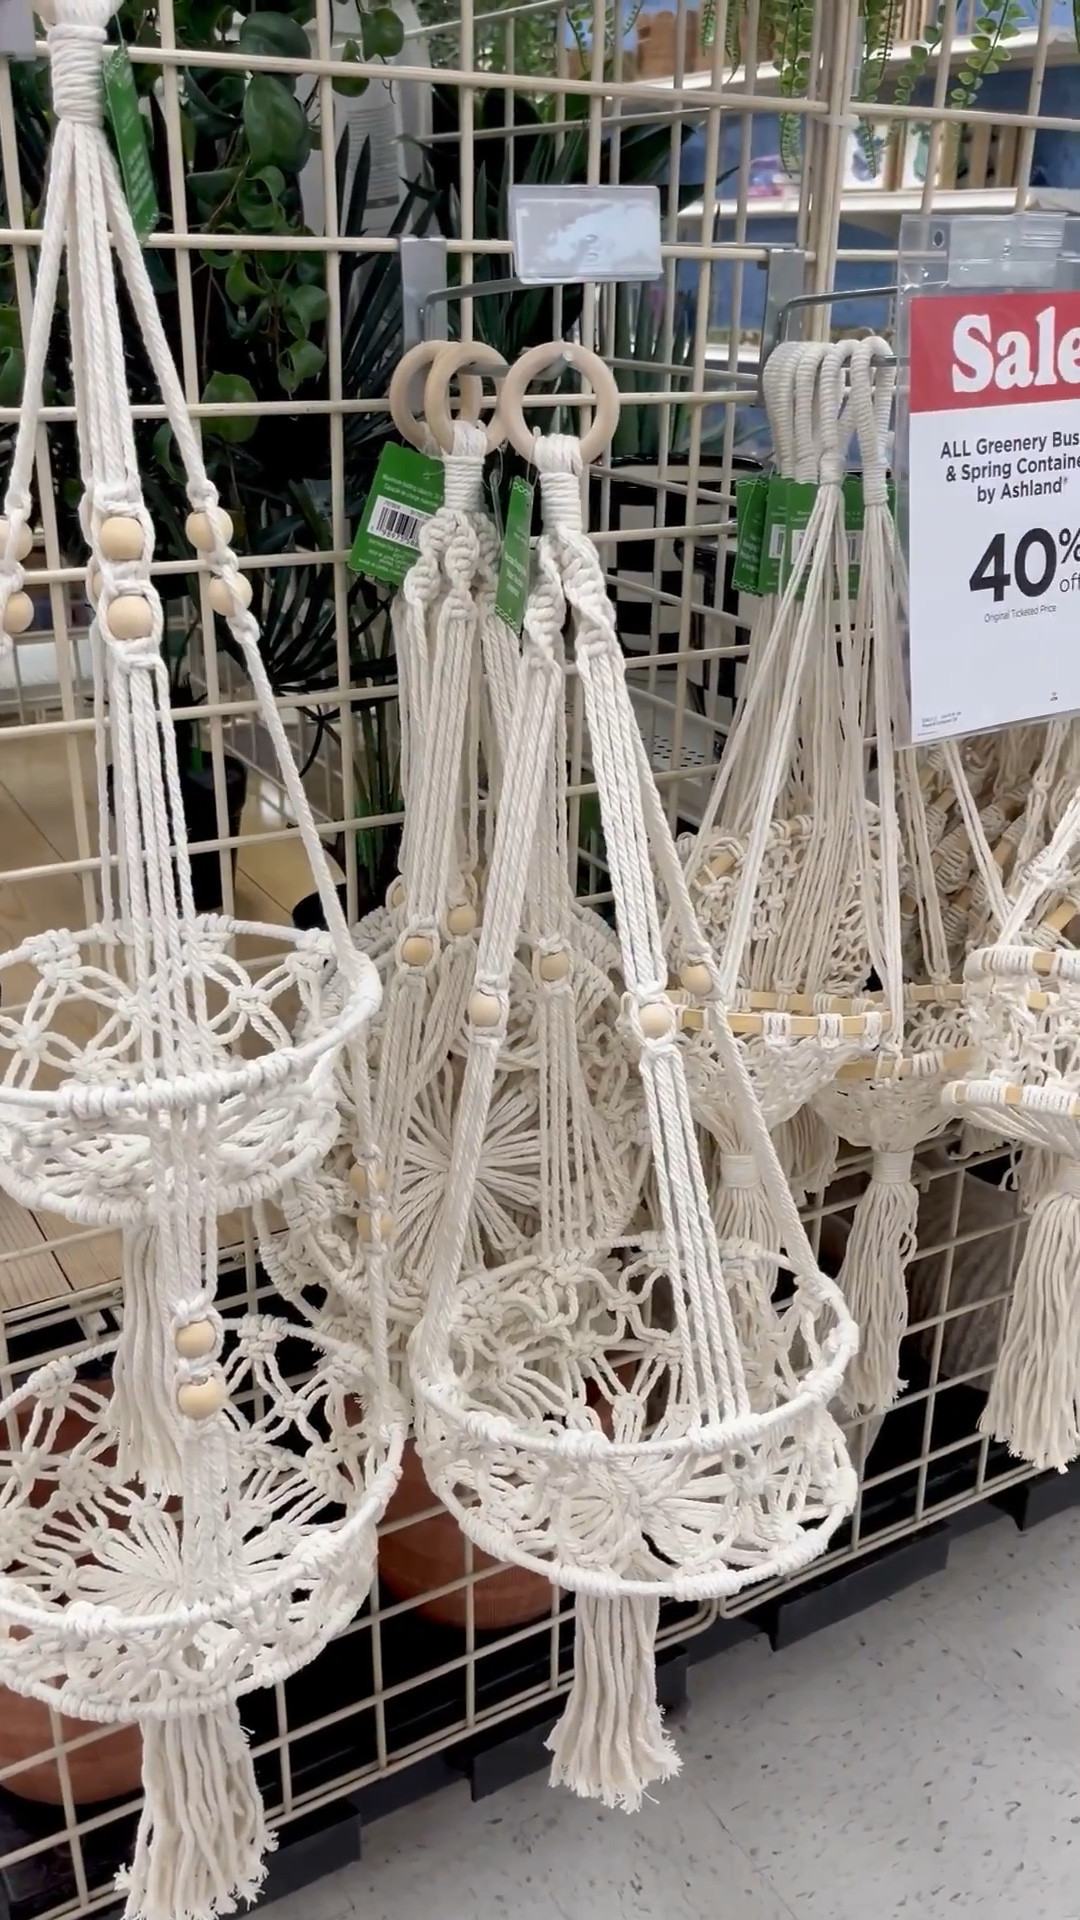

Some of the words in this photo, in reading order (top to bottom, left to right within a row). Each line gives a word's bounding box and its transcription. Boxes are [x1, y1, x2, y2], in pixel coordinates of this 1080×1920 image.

[952, 306, 1080, 392] Sale
[940, 440, 971, 459] ALL
[976, 435, 1047, 455] Greenery
[945, 465, 957, 482] &
[961, 461, 1012, 483] Spring
[977, 484, 996, 504] by
[969, 527, 1080, 602] 40%
[984, 609, 1010, 623] Original
[1040, 604, 1057, 613] Price
